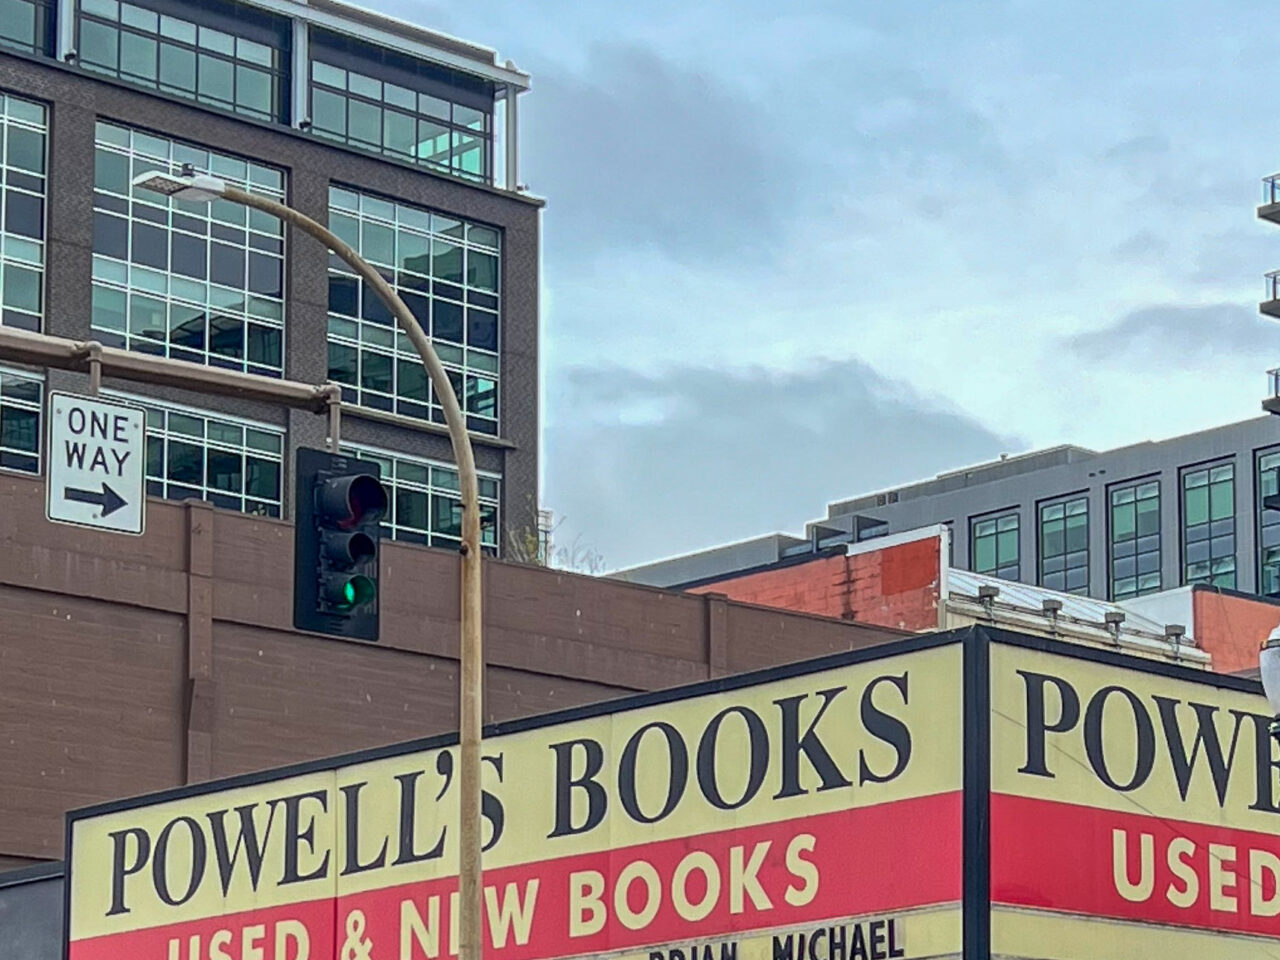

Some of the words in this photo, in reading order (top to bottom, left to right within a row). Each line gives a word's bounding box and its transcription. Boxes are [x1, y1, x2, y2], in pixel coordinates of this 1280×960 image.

[65, 441, 131, 476] WAY
[68, 408, 130, 443] ONE
[546, 672, 912, 839] BOOKS
[568, 833, 819, 939] BOOKS
